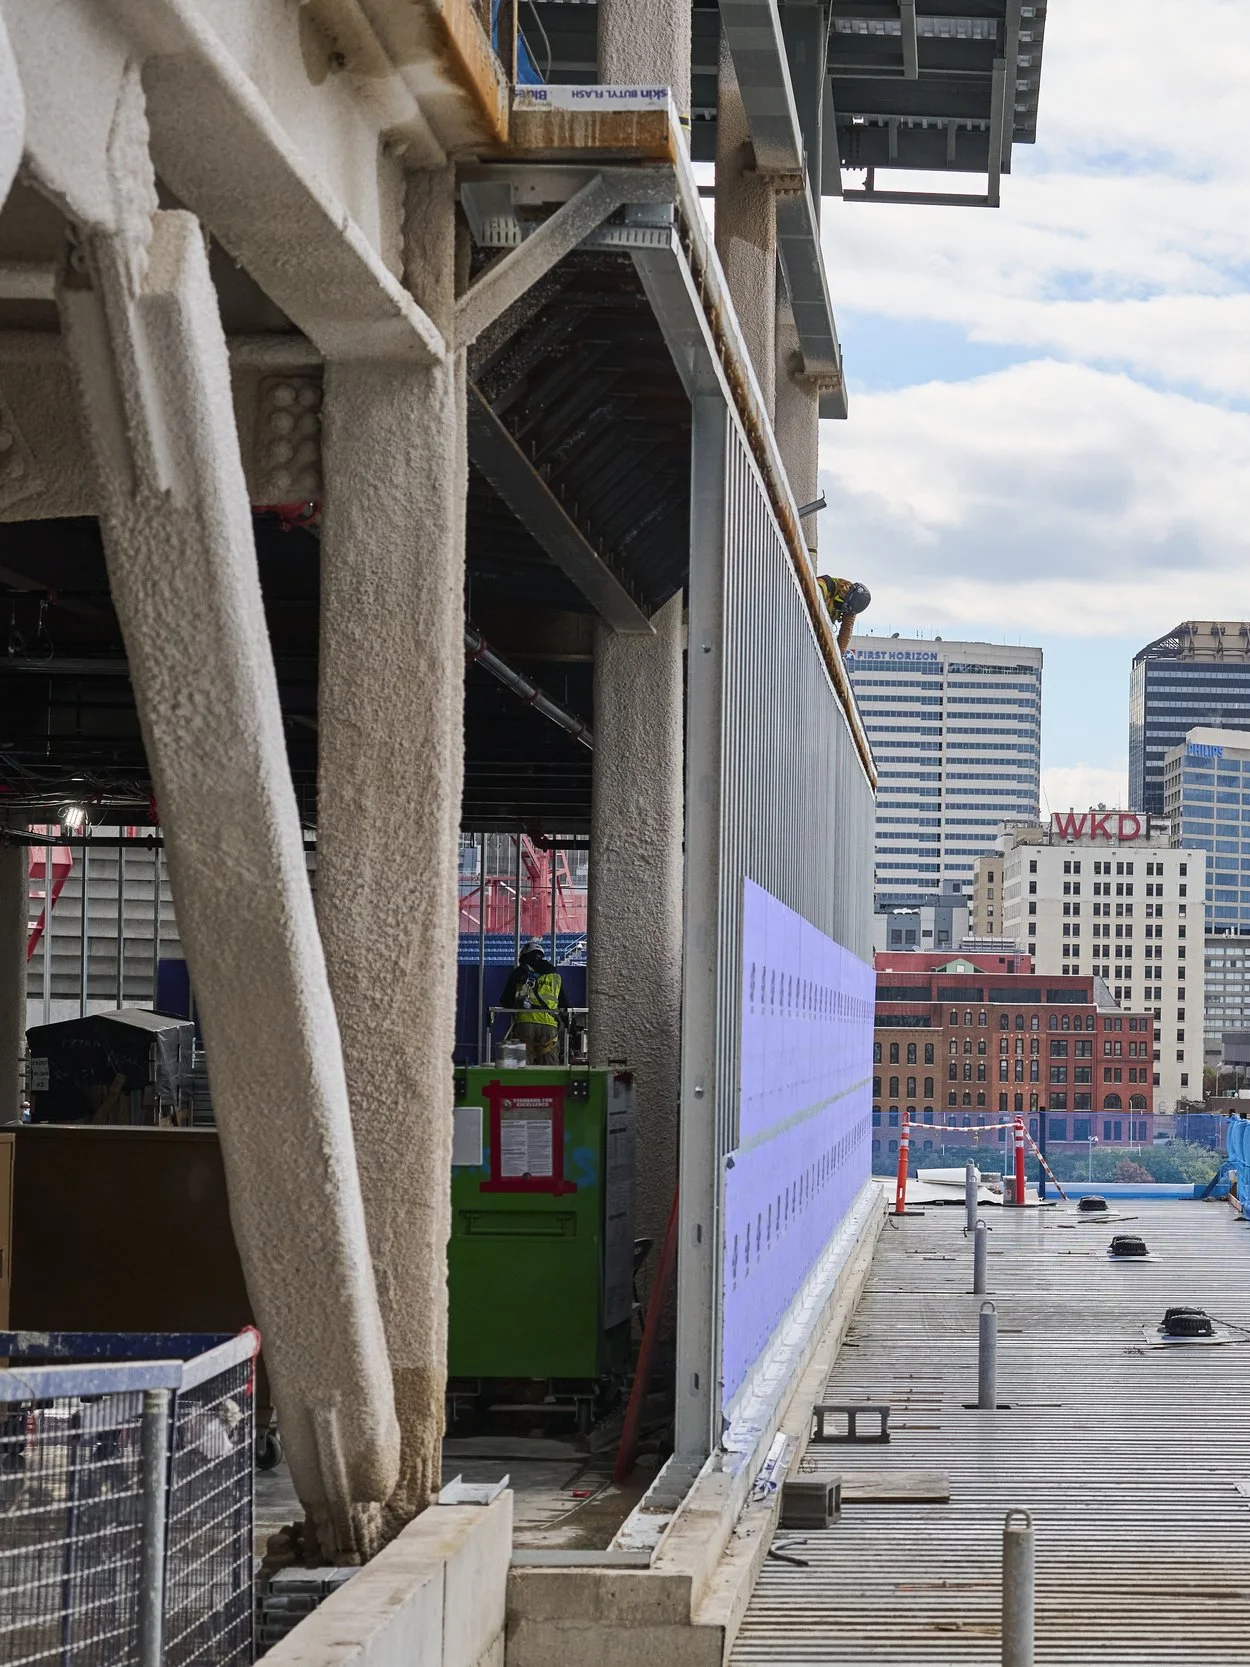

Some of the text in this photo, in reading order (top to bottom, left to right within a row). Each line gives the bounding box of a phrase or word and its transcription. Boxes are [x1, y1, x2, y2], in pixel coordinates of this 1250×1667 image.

[571, 89, 603, 98] FLASH
[605, 89, 639, 98] BUTYL
[857, 650, 938, 661] FIRST HORIZON
[1187, 743, 1224, 759] PHILIPS
